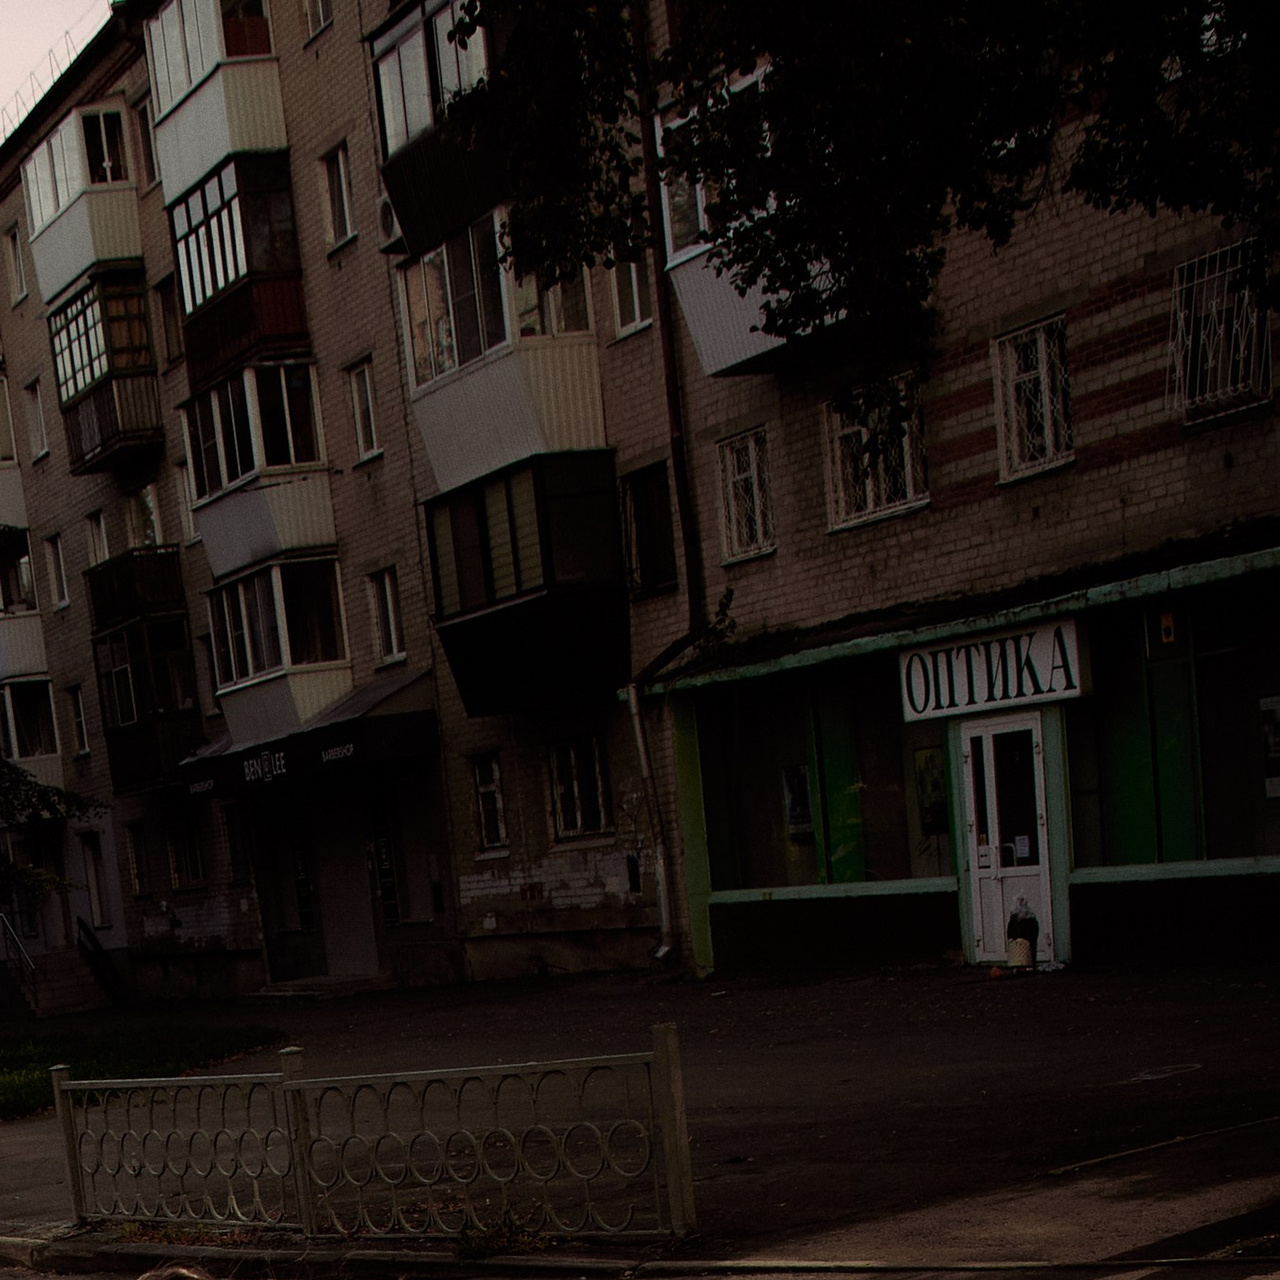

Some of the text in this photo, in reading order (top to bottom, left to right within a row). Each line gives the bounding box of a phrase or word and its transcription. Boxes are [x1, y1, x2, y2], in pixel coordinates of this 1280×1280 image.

[905, 624, 1077, 714] ОПТИКА
[243, 751, 287, 781] BEN LEE
